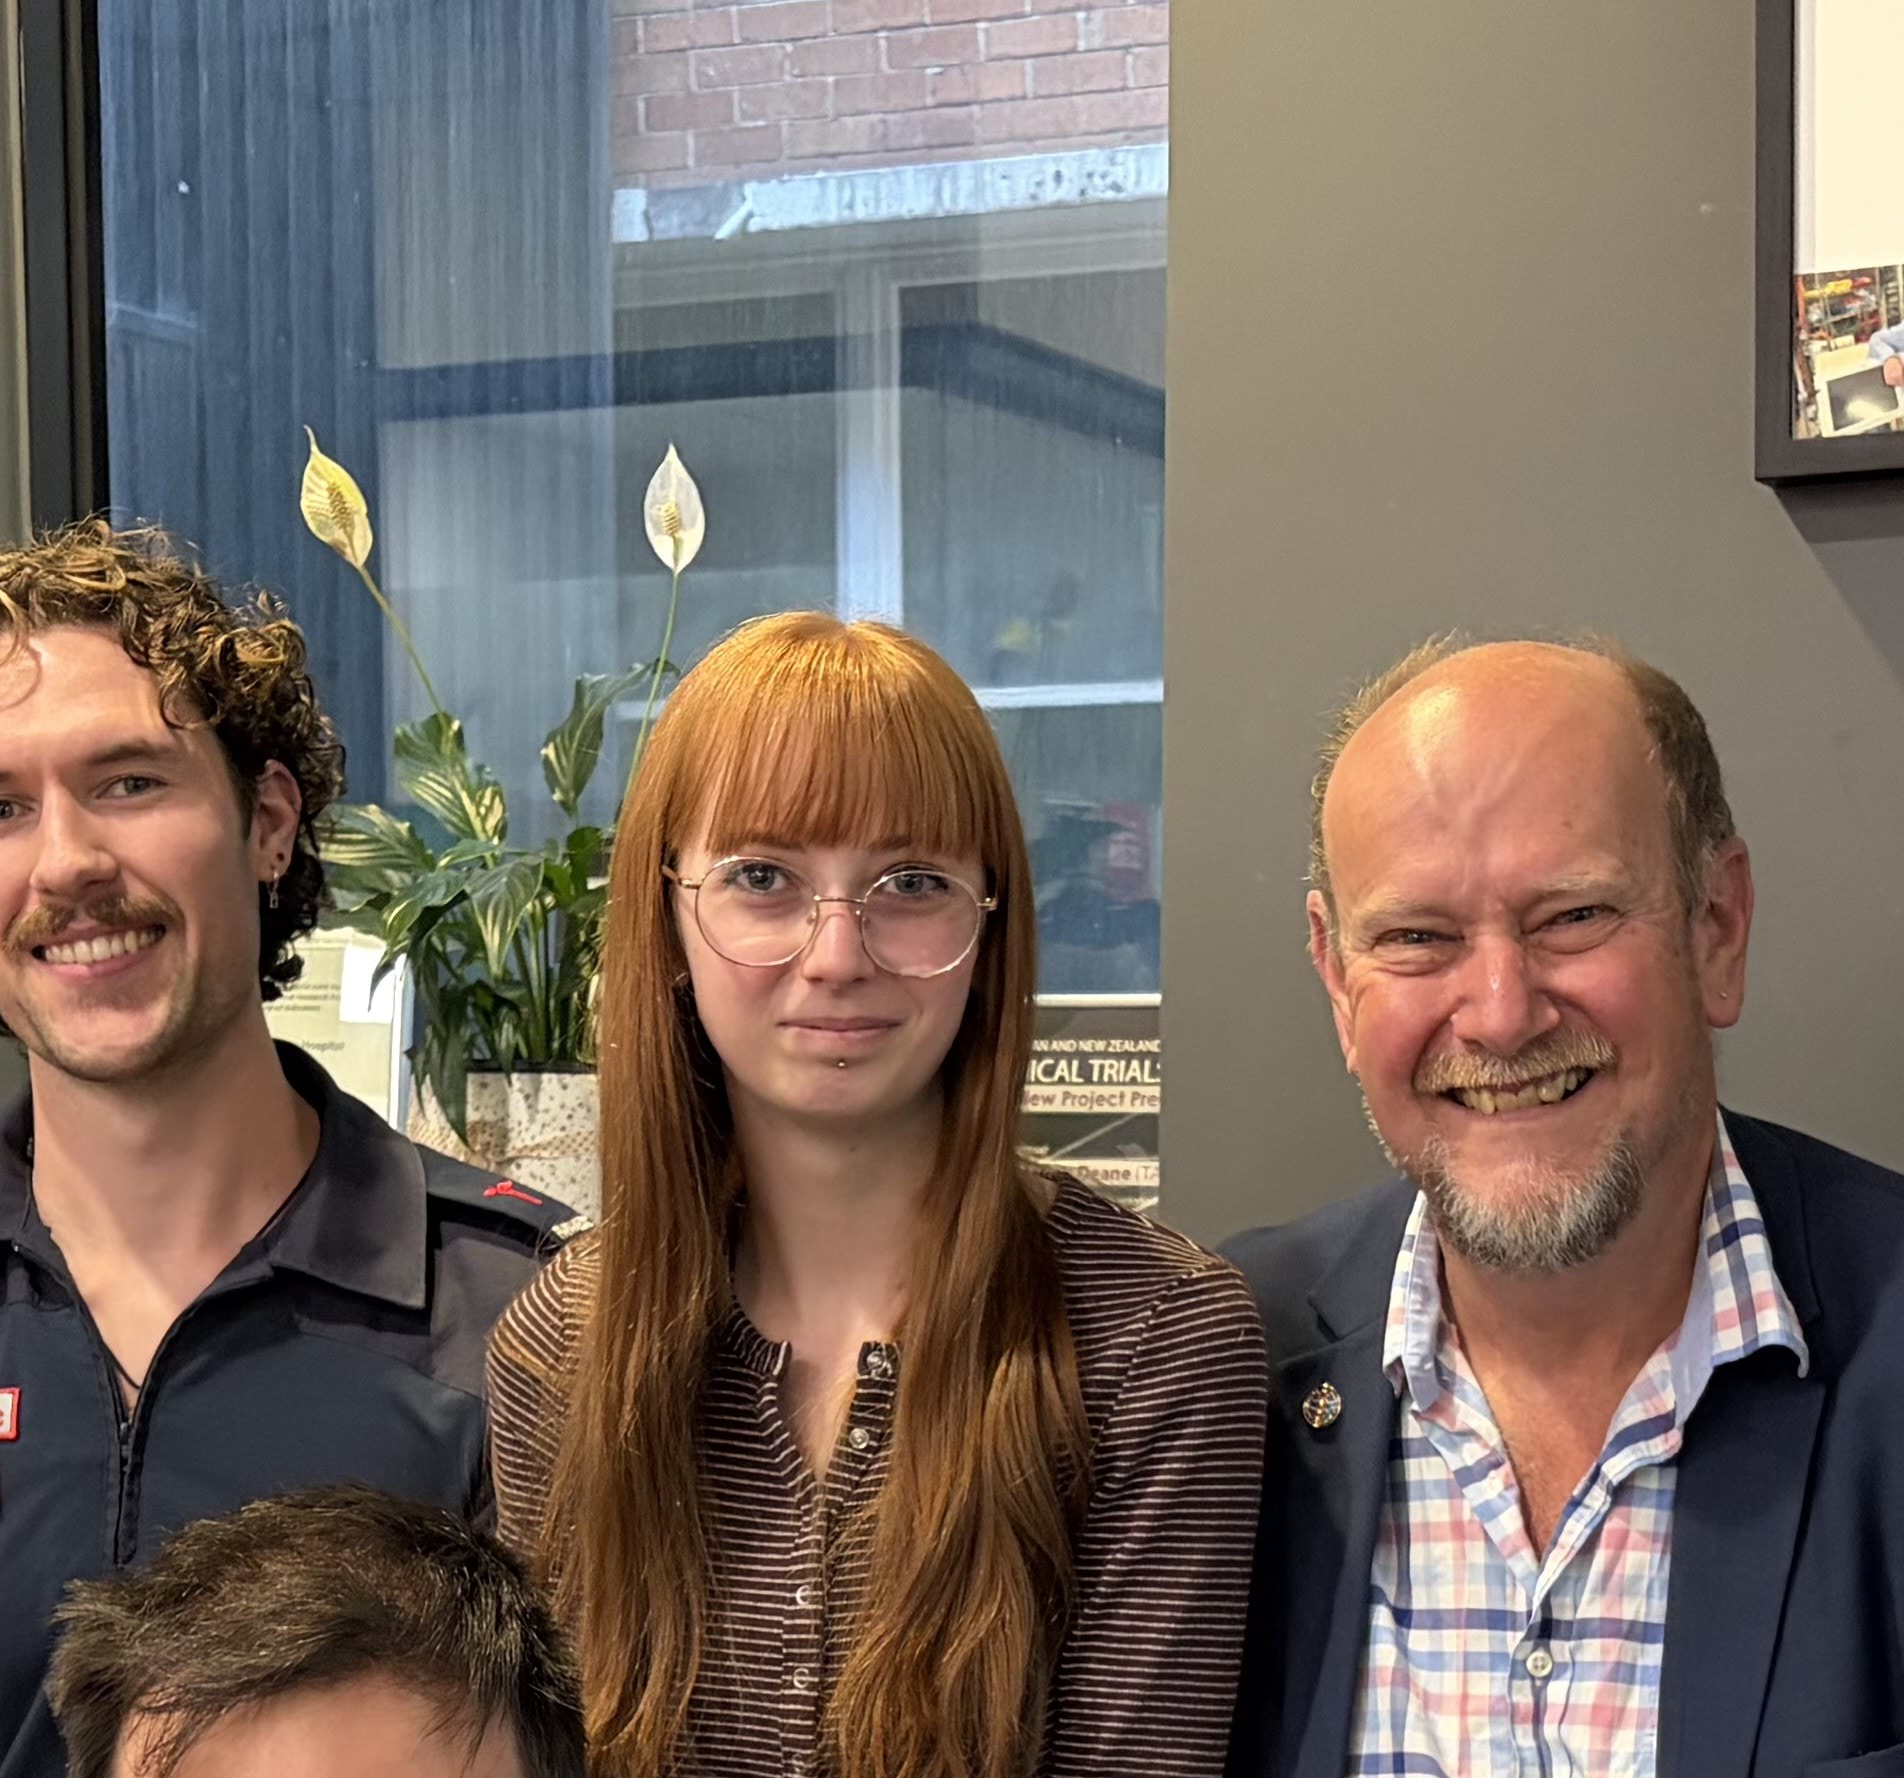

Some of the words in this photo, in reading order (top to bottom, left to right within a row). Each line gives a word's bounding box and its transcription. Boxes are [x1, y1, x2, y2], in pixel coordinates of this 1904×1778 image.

[1051, 1039, 1077, 1052] AND
[1078, 1039, 1107, 1052] NEW
[1088, 1059, 1161, 1083] TRIAL
[1061, 1090, 1125, 1110] Project
